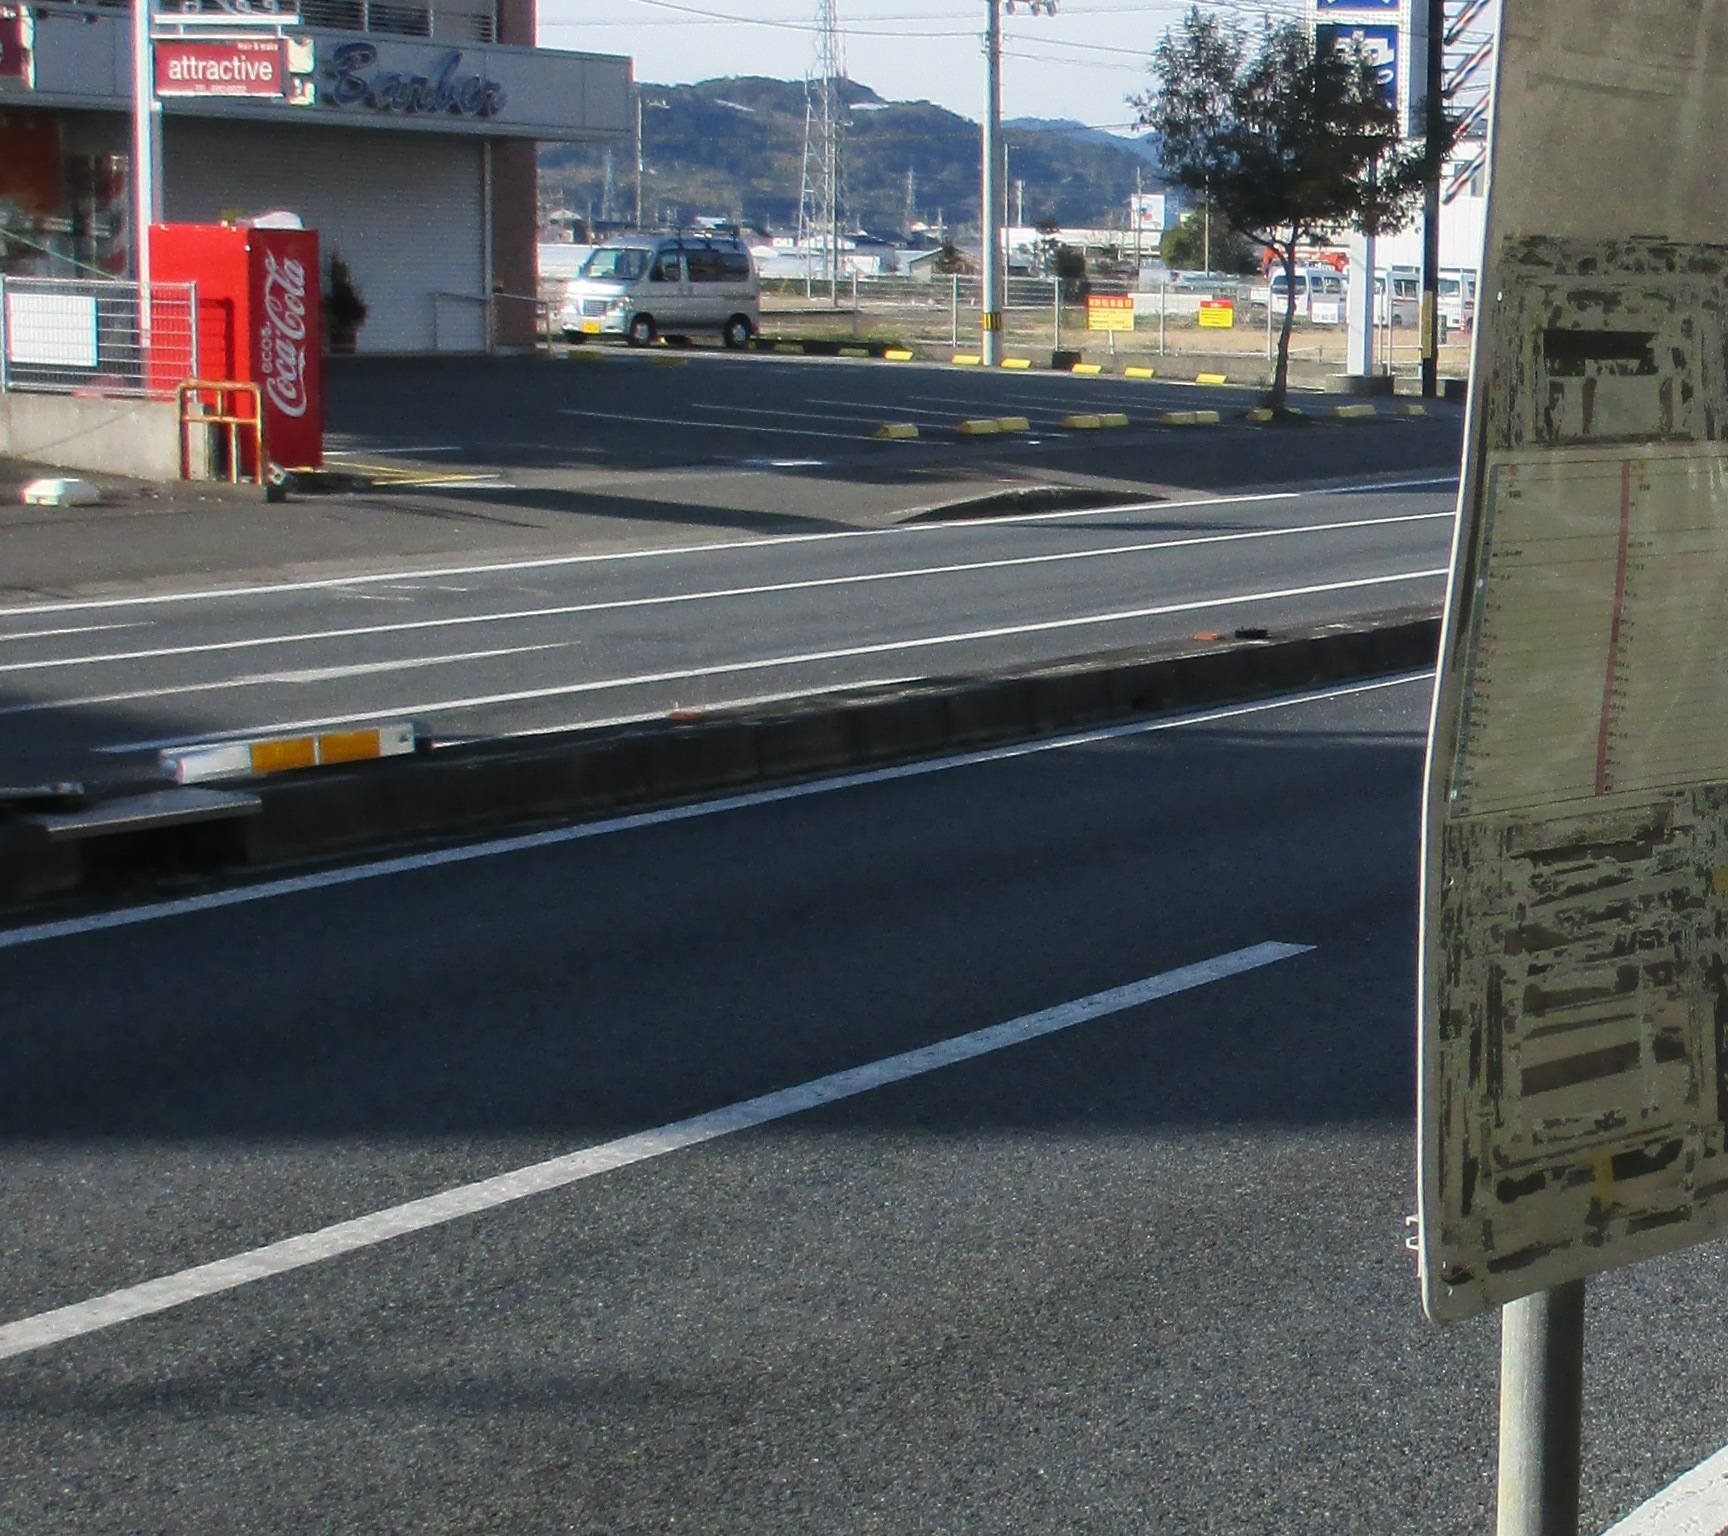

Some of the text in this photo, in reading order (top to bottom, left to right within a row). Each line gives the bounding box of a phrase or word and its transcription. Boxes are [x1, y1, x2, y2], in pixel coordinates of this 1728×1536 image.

[168, 54, 273, 82] attractive
[332, 42, 509, 115] Barber
[264, 247, 308, 418] Coca-Cola
